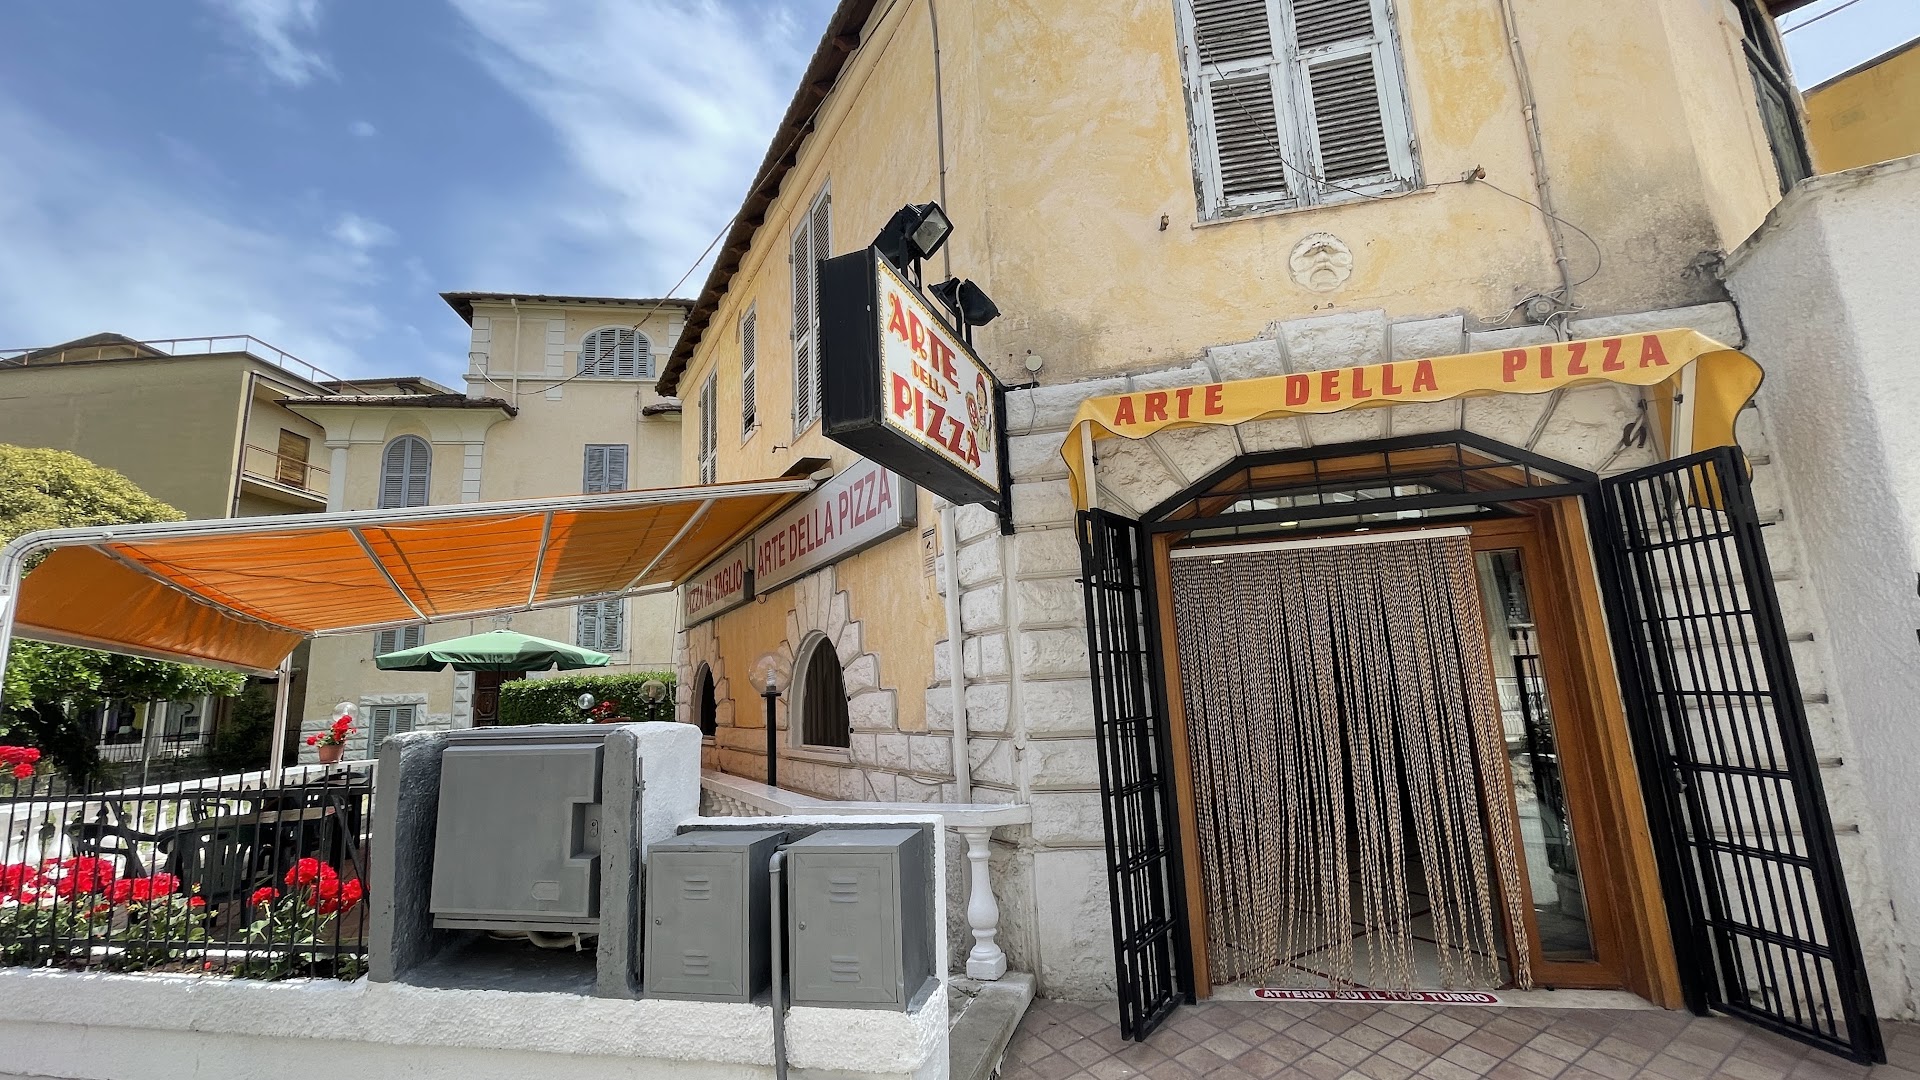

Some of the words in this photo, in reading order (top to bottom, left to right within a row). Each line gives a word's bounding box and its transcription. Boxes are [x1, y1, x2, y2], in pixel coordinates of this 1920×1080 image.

[888, 291, 959, 388] ARTE
[911, 358, 948, 402] DELLA
[1114, 384, 1224, 426] ARTE
[1285, 359, 1438, 407] DELLA
[1502, 334, 1670, 383] PIZZA
[890, 371, 981, 469] PIZZA
[757, 529, 786, 580] ARTE
[789, 500, 834, 562] DELLA
[838, 465, 892, 536] PIZZA
[686, 584, 704, 616] PIZZA
[704, 578, 714, 607] AL
[714, 559, 743, 602] TAGLIO
[1263, 990, 1332, 999] ATTENDI
[1367, 991, 1387, 1001] IL
[1425, 993, 1490, 1003] TURNO
